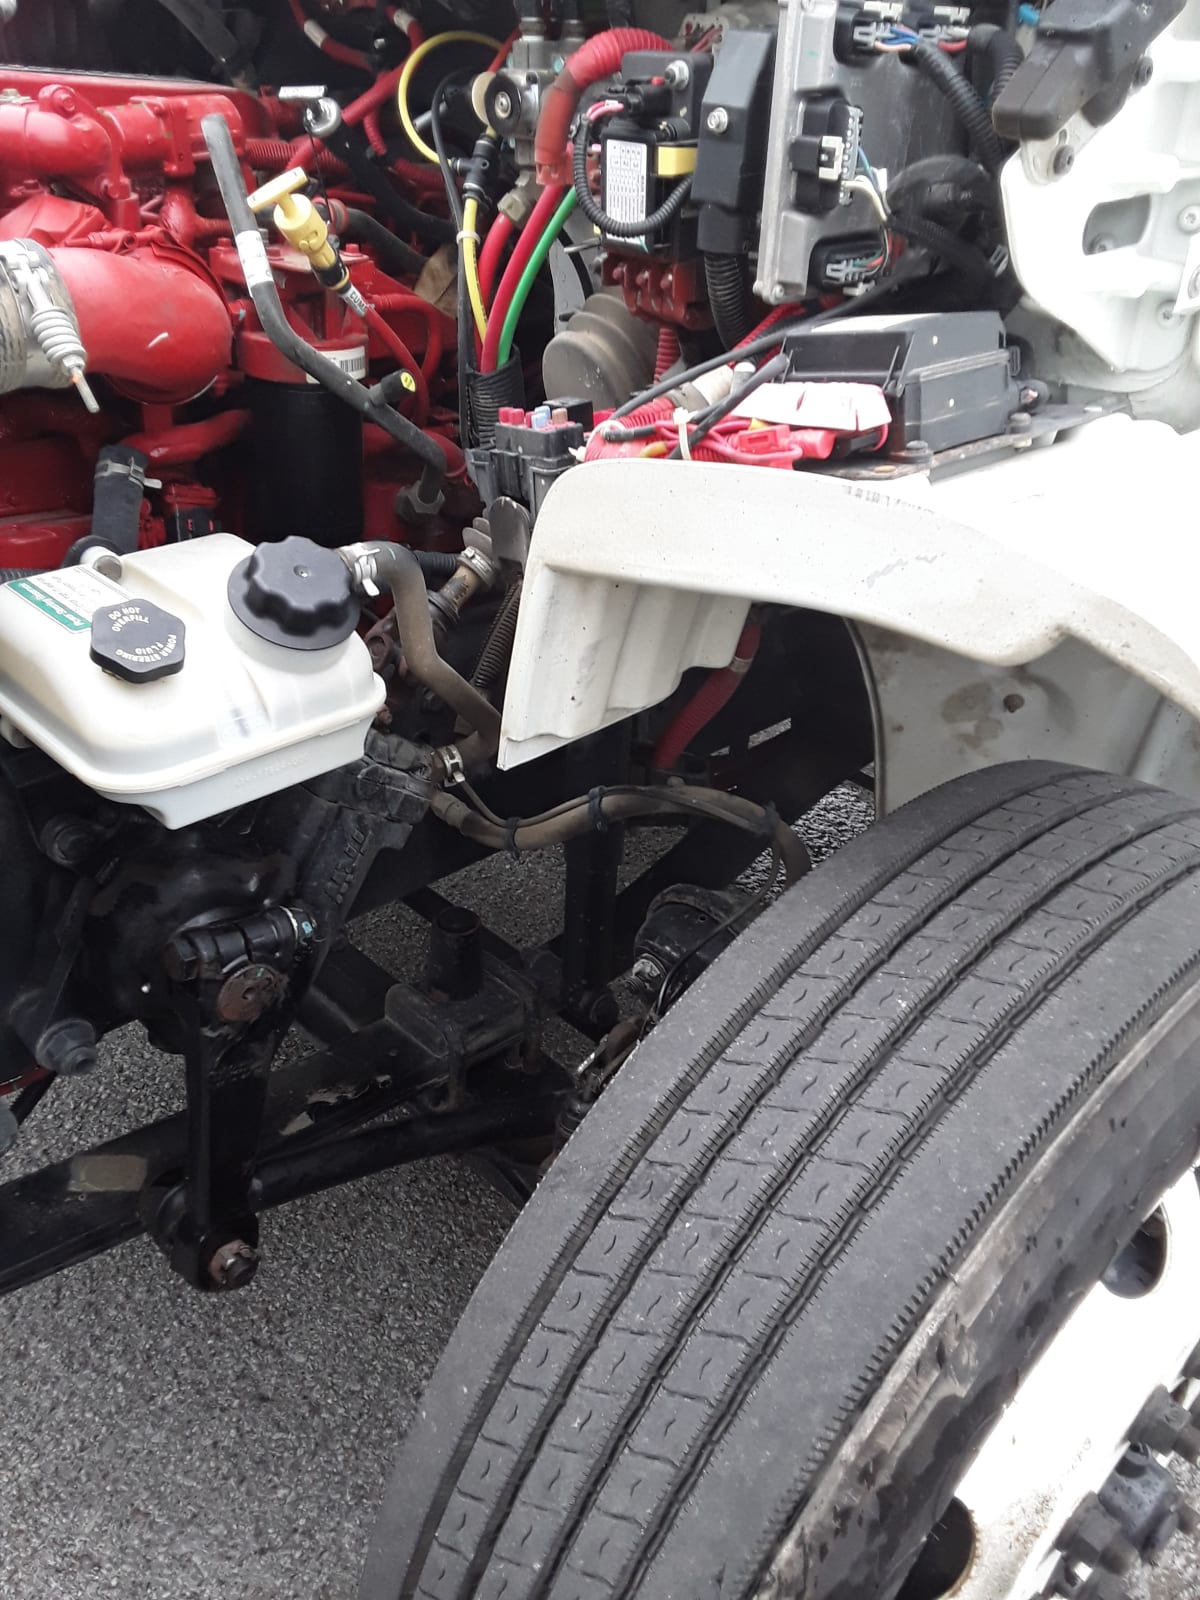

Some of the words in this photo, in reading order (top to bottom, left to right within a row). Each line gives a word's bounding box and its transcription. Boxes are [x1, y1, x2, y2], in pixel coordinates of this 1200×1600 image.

[108, 610, 122, 620] DO
[121, 606, 140, 615] NOT
[111, 614, 150, 632] OVERFILL
[135, 641, 165, 655] FLUID
[160, 634, 177, 657] POWER
[115, 648, 161, 663] STEERING
